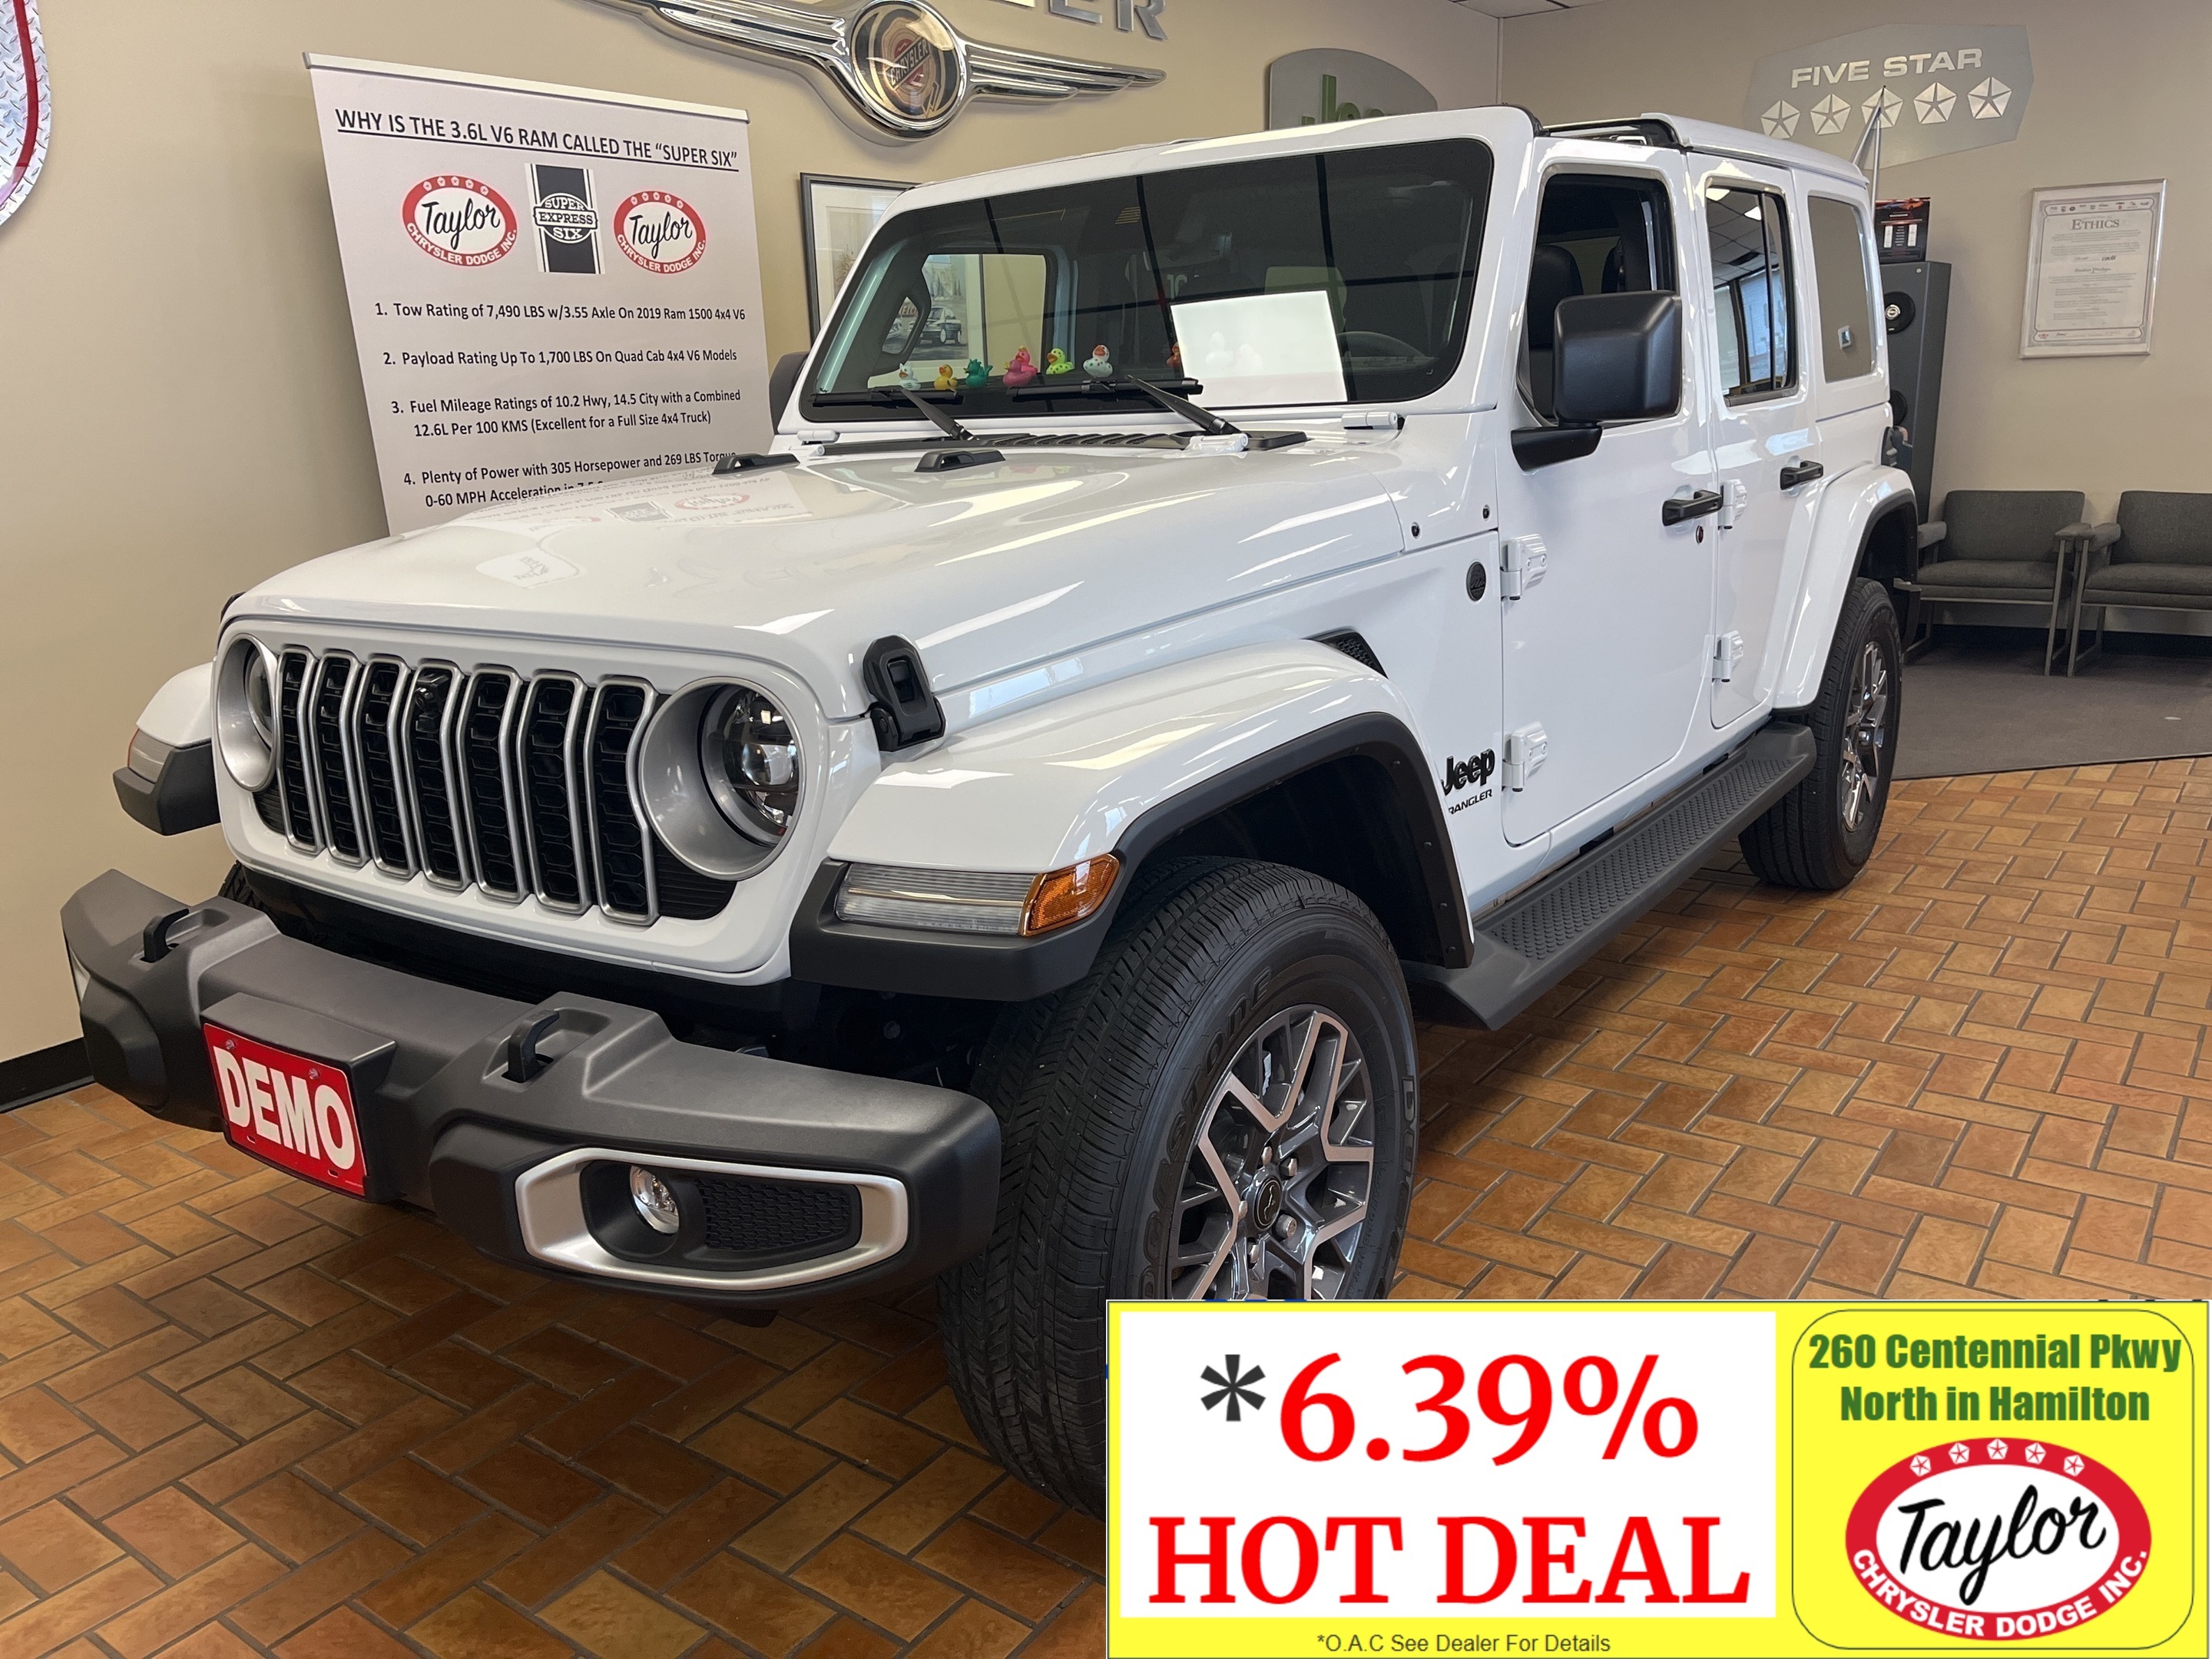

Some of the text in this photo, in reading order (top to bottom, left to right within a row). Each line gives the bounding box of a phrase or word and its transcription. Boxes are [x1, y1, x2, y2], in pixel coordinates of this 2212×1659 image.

[1791, 48, 1982, 89] FIVE STAR
[335, 109, 382, 131] WHY
[389, 114, 405, 133] IS
[409, 117, 445, 137] THE
[450, 121, 487, 141] 3.6L
[491, 125, 513, 144] V6
[518, 128, 558, 148] RAM
[563, 133, 619, 154] CALLED
[623, 140, 651, 158] THE
[539, 211, 593, 225] EXPRESS
[545, 197, 585, 211] SUPER
[422, 197, 500, 250] Taylor
[553, 227, 583, 240] SIX
[629, 211, 693, 260] Taylor
[2071, 219, 2120, 230] ETHICS
[406, 223, 517, 265] CHRYSLER DODGE INC.
[617, 234, 706, 273] CHRYSLER DODGE INC.
[375, 303, 746, 320] 1. Tow Rating of 7,490 LBS w/3.55 Axle On 2019 Ram 1500 4x4 V6
[382, 349, 737, 368] 2. Payload Rating Up To 1,700 LBS On Quad Cab 4x4 V6 Models
[391, 389, 741, 413] 3. Fuel Mileage Ratings of 10.2 Hwy, 14.5 City with a Combined
[414, 410, 711, 437] 12.6L Per 100 KMS (Excellent for a Full Size 4x4 Truck)
[403, 452, 736, 485] 4. Plenty of Power with 305 Horsepower and 269 LBS Tor
[426, 494, 452, 507] 0-60
[456, 491, 486, 505] MPH
[1441, 748, 1495, 796] Jeep
[213, 1046, 355, 1170] DEMO
